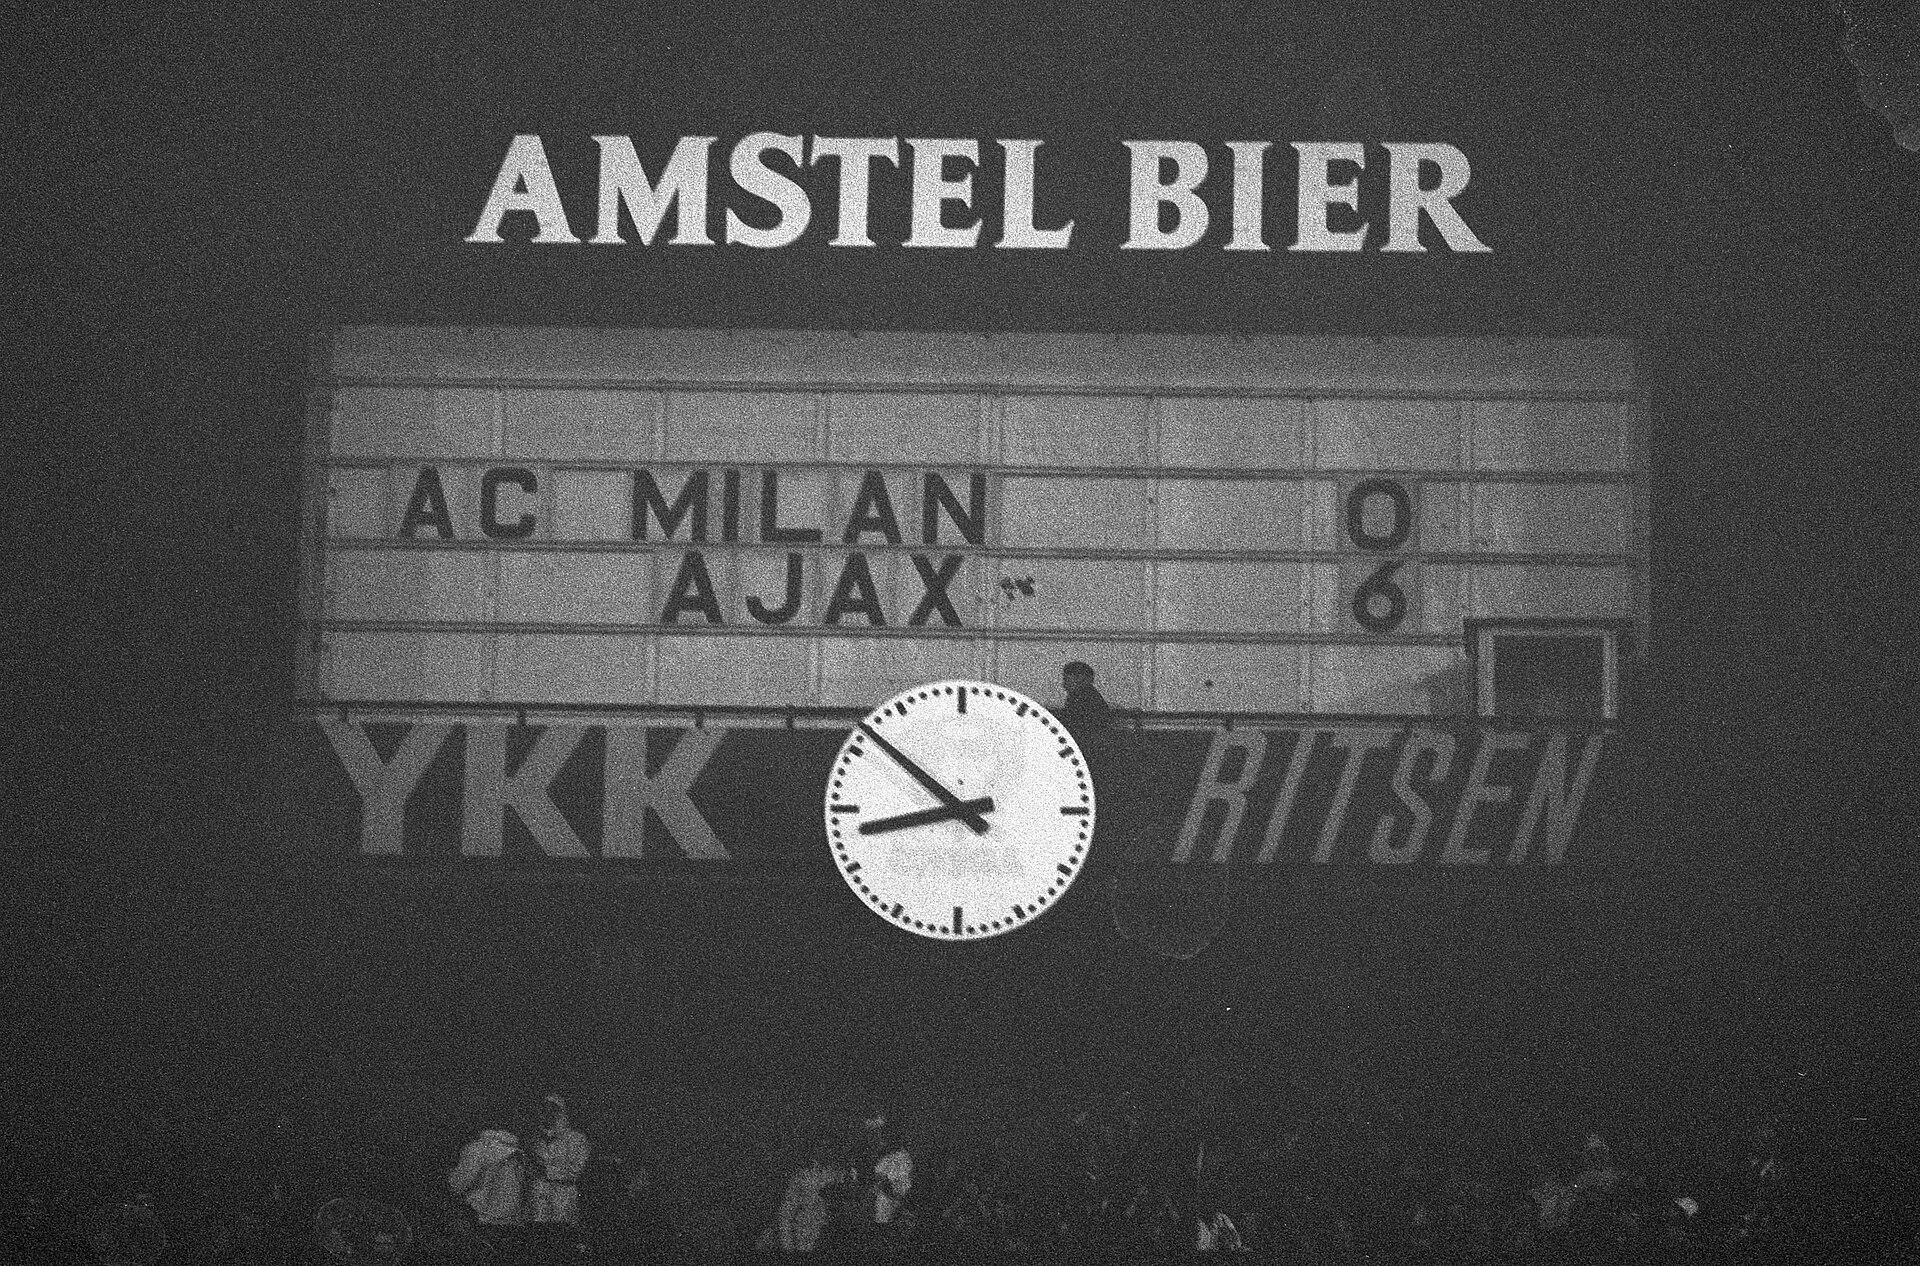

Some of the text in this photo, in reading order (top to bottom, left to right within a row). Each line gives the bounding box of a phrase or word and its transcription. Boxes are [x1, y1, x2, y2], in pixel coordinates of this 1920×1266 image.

[464, 132, 1493, 253] AMSTEL BIER
[401, 466, 538, 540] AC
[631, 469, 987, 545] MILAN
[660, 551, 1406, 632] AJAX 6
[315, 716, 1606, 866] YKK RITSEN
